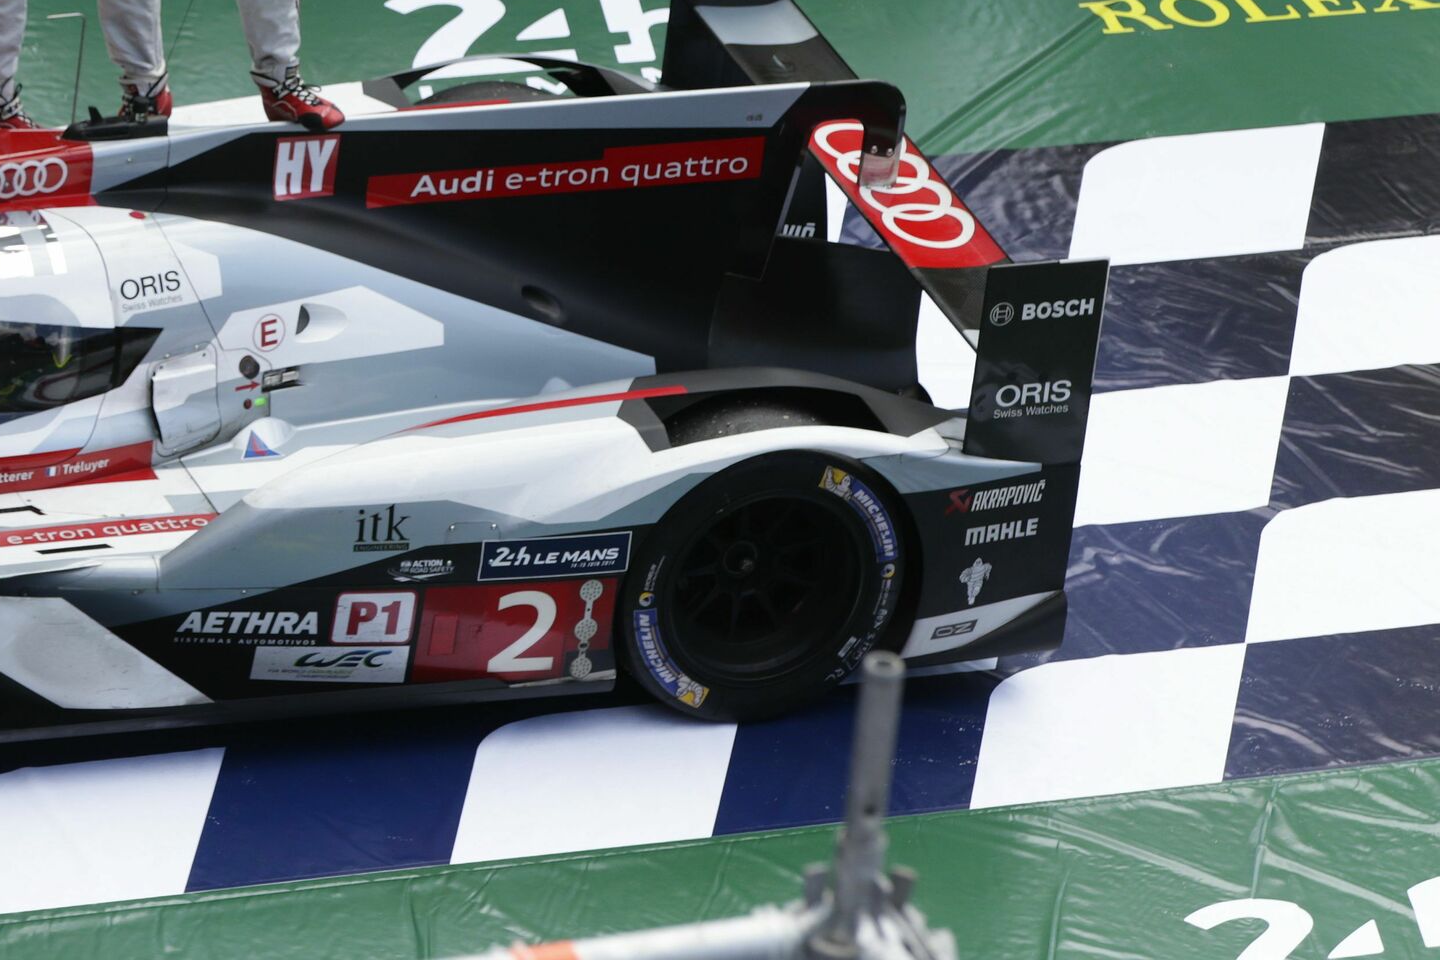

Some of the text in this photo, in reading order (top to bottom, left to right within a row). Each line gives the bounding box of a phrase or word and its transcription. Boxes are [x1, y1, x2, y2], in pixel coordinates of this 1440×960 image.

[274, 140, 337, 195] HY
[410, 154, 749, 198] Audi e-tron quattro
[120, 270, 182, 300] ORIS
[121, 293, 184, 313] Swiss Watches
[1021, 297, 1096, 321] BOSCH
[261, 318, 278, 348] E
[995, 379, 1073, 408] ORIS
[993, 403, 1069, 419] Swiss Watches
[63, 457, 110, 476] Tréluyer
[10, 525, 94, 544] e-tron
[103, 515, 209, 539] quattro
[355, 504, 412, 542] itk
[853, 489, 894, 558] MICHELIN
[964, 517, 1040, 547] MAHLE
[412, 559, 443, 568] ACTION
[489, 546, 620, 568] 24h LE MANS
[176, 611, 319, 635] AETHRA
[345, 599, 402, 636] P1
[486, 590, 558, 673] 2
[237, 638, 317, 646] AUTOMOTIVOS
[638, 613, 677, 684] MICHELIN
[293, 649, 393, 669] WEC
